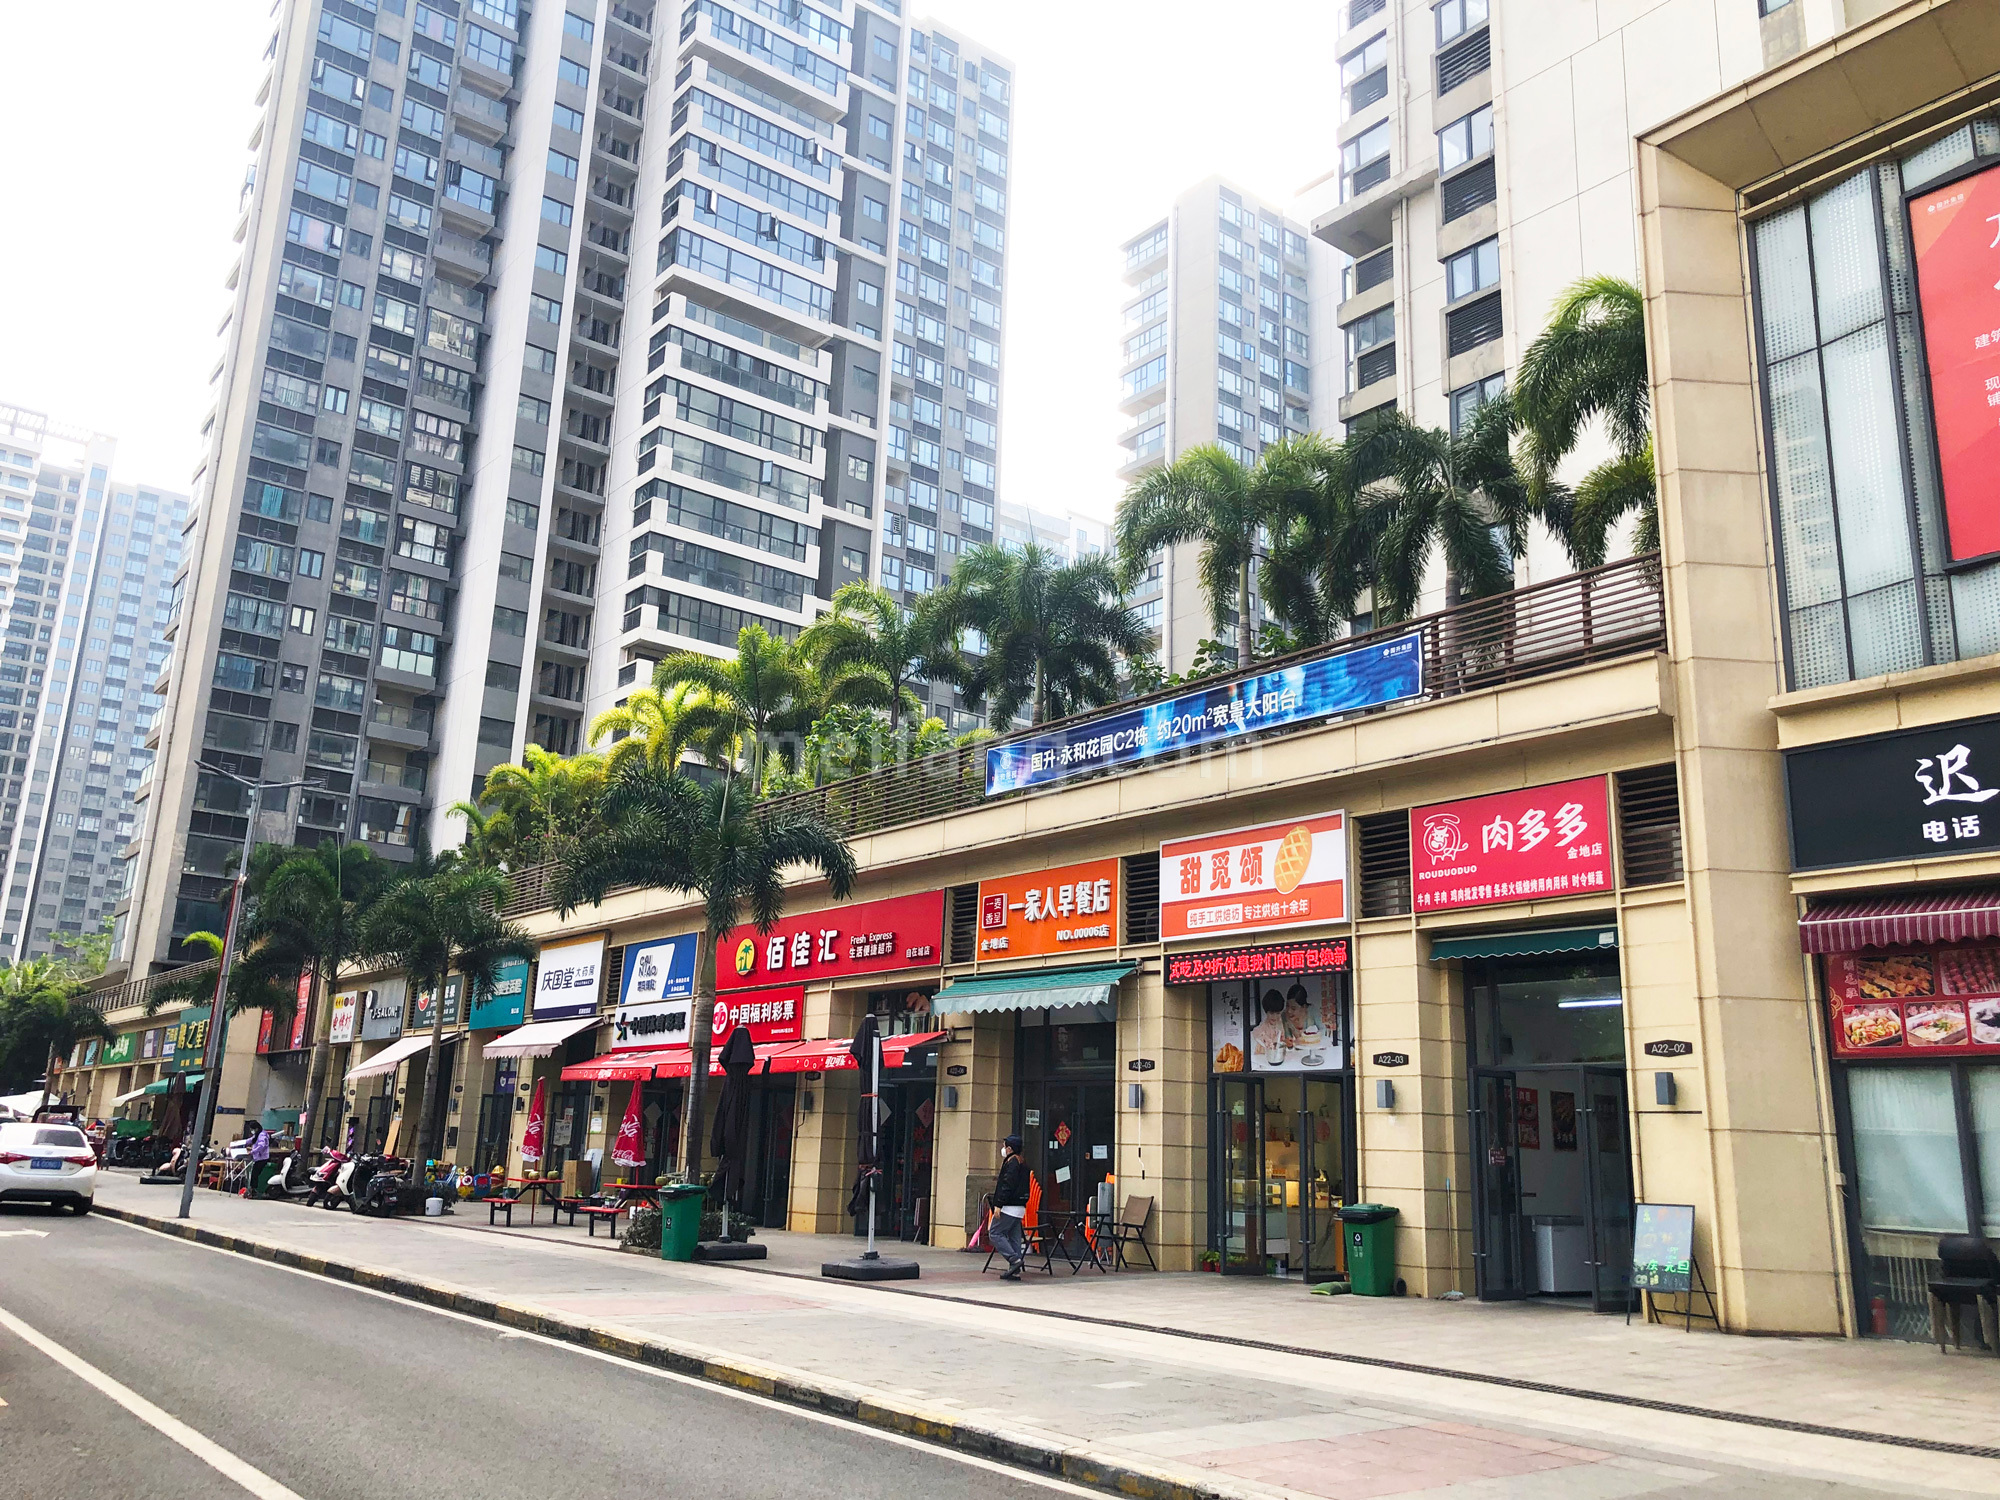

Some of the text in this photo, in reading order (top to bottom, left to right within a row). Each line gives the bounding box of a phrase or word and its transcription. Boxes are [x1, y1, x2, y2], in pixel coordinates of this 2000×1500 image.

[1031, 724, 1148, 773] 国升·永和花园C2栋
[1482, 802, 1588, 854] 肉多多
[1922, 814, 1980, 842] 电话
[1566, 842, 1603, 860] 金地店
[1179, 845, 1263, 895] 甜觅颂
[1418, 864, 1478, 881] ROUDUODUO
[1008, 878, 1111, 922] 一家人早餐店
[1416, 892, 1431, 907] 牛肉
[1433, 889, 1448, 905] 羊肉
[1450, 883, 1492, 903] 鸡肉批发零售
[1189, 898, 1309, 927] 纯手工烘焙坊 专注烘焙十余年
[766, 928, 838, 971] 佰佳汇
[848, 941, 893, 959] 生活便捷超市
[850, 930, 893, 946] Fresh Express
[541, 967, 574, 992] 庆国堂
[729, 999, 795, 1026] 中国福利彩票
[1378, 1055, 1404, 1064] A22-03
[1651, 1043, 1686, 1054] A22-02
